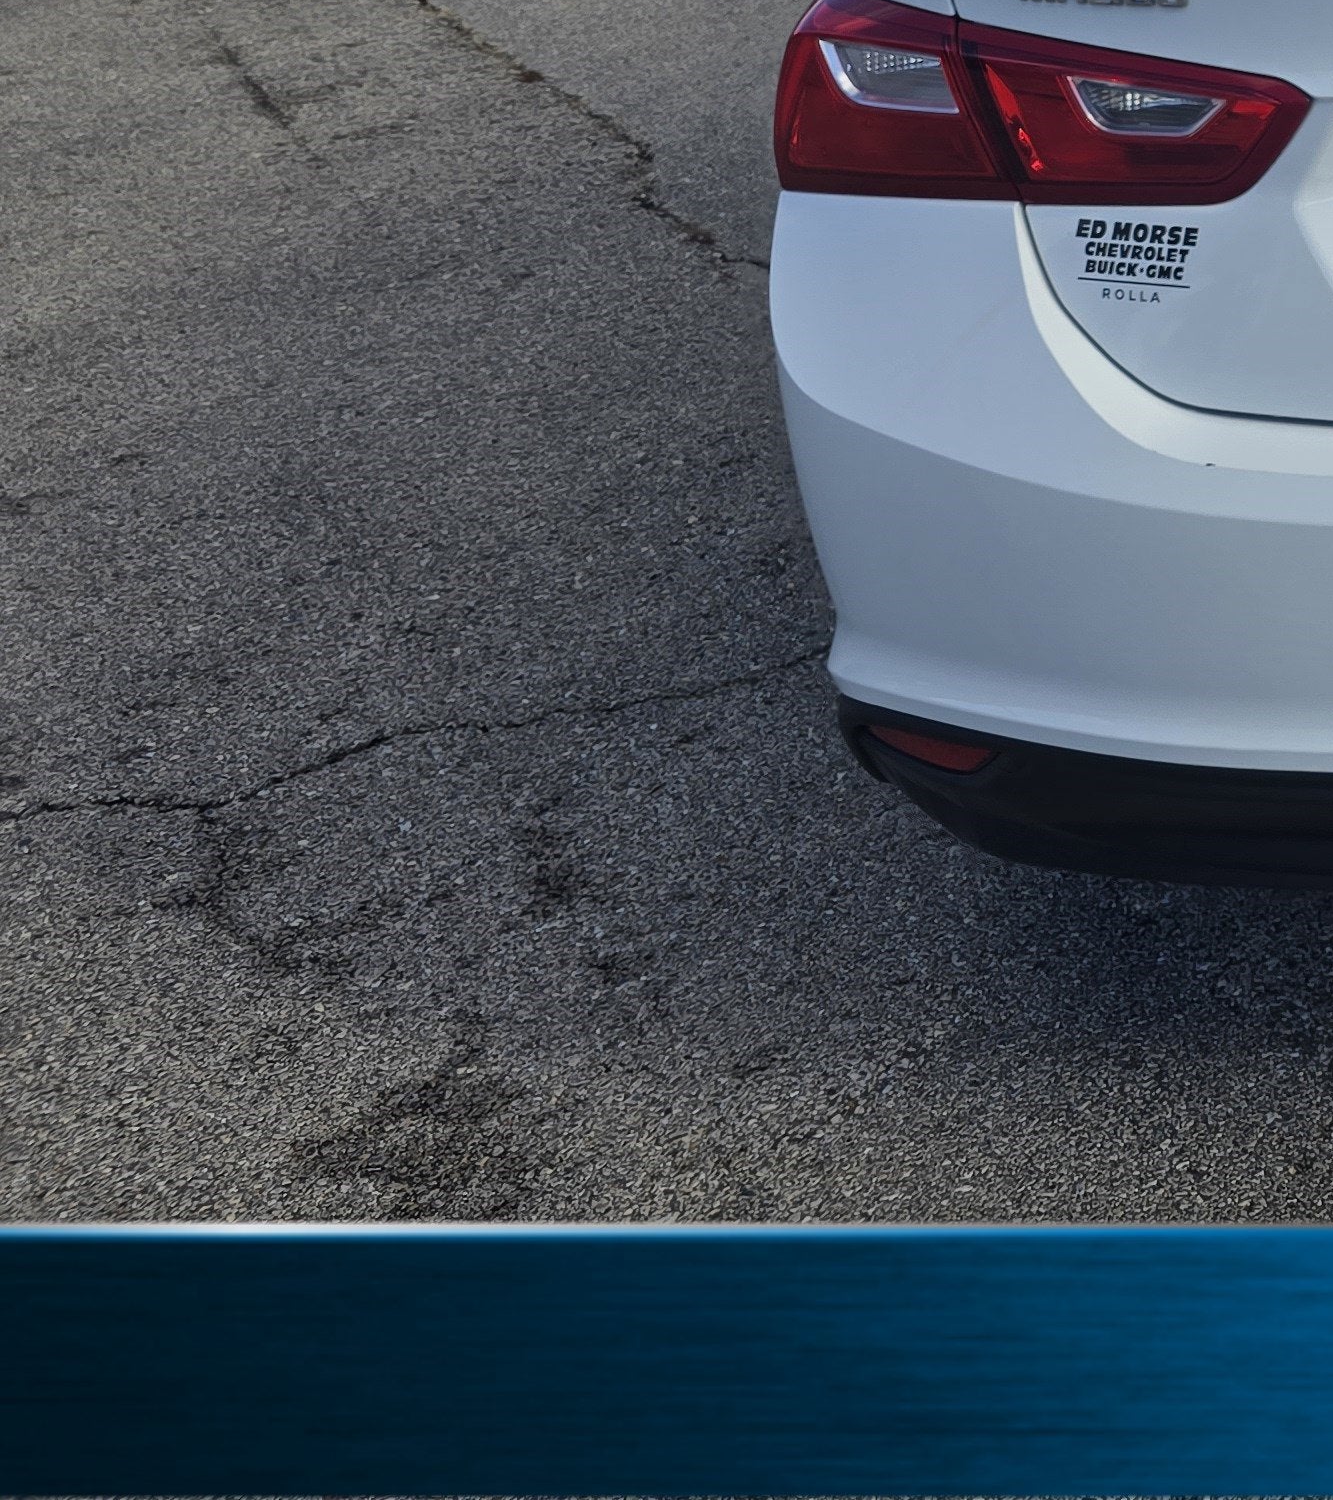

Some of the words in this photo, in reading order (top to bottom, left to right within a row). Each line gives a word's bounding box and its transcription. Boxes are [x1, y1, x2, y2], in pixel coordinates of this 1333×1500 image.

[1075, 218, 1108, 239] ED
[1111, 221, 1200, 246] MORSE
[1084, 241, 1190, 263] CHEVROLET
[1101, 287, 1161, 303] ROLLA
